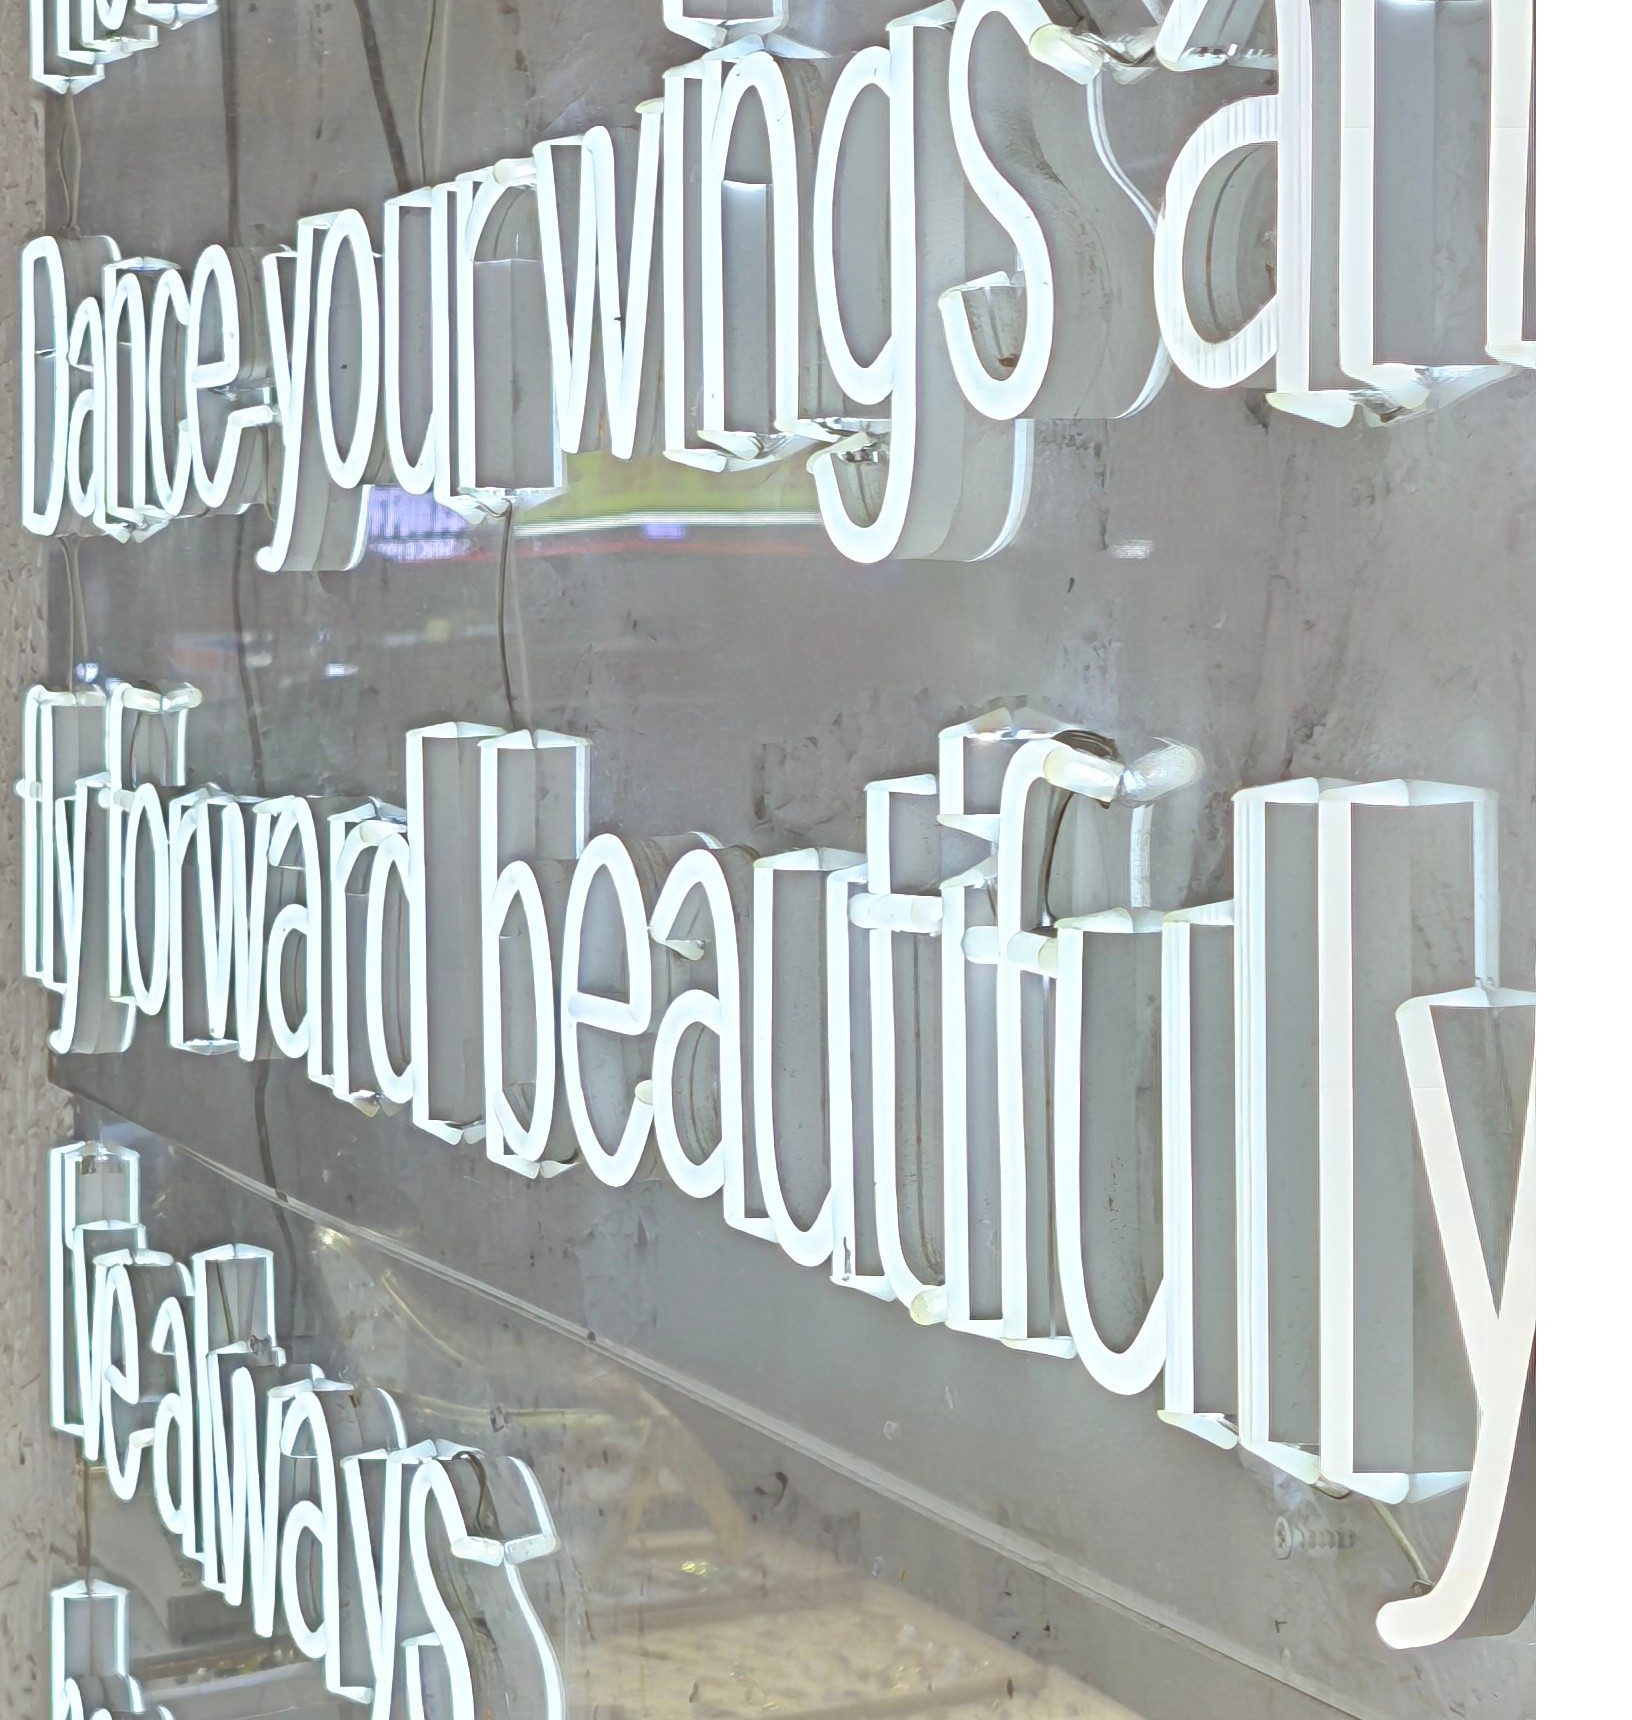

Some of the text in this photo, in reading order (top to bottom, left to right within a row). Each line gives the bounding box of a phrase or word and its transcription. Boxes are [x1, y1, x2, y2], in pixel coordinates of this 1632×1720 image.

[20, 234, 274, 540] Dance
[256, 160, 538, 571] your
[16, 681, 1536, 1649] fly forward beautifully
